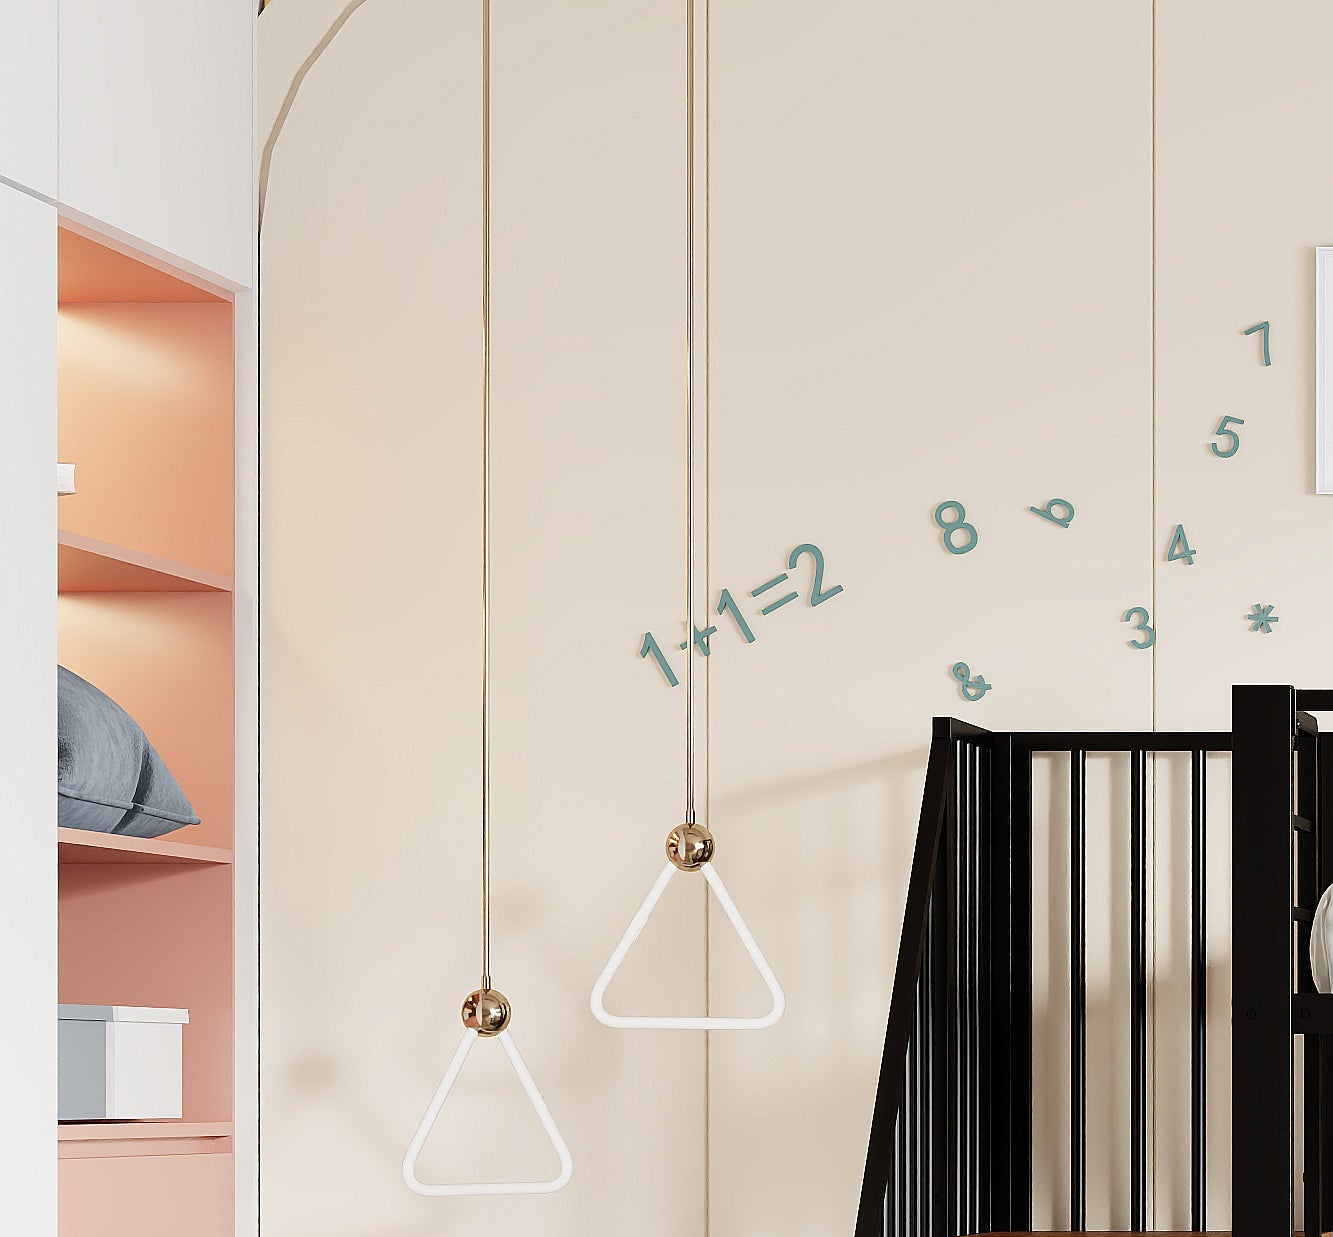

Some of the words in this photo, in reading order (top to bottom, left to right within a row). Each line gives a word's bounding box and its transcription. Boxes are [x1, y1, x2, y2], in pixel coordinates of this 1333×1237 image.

[1244, 321, 1272, 367] 7
[1211, 415, 1245, 459] 5
[935, 500, 978, 555] 8
[1167, 524, 1197, 566] 4
[1125, 606, 1155, 650] 3
